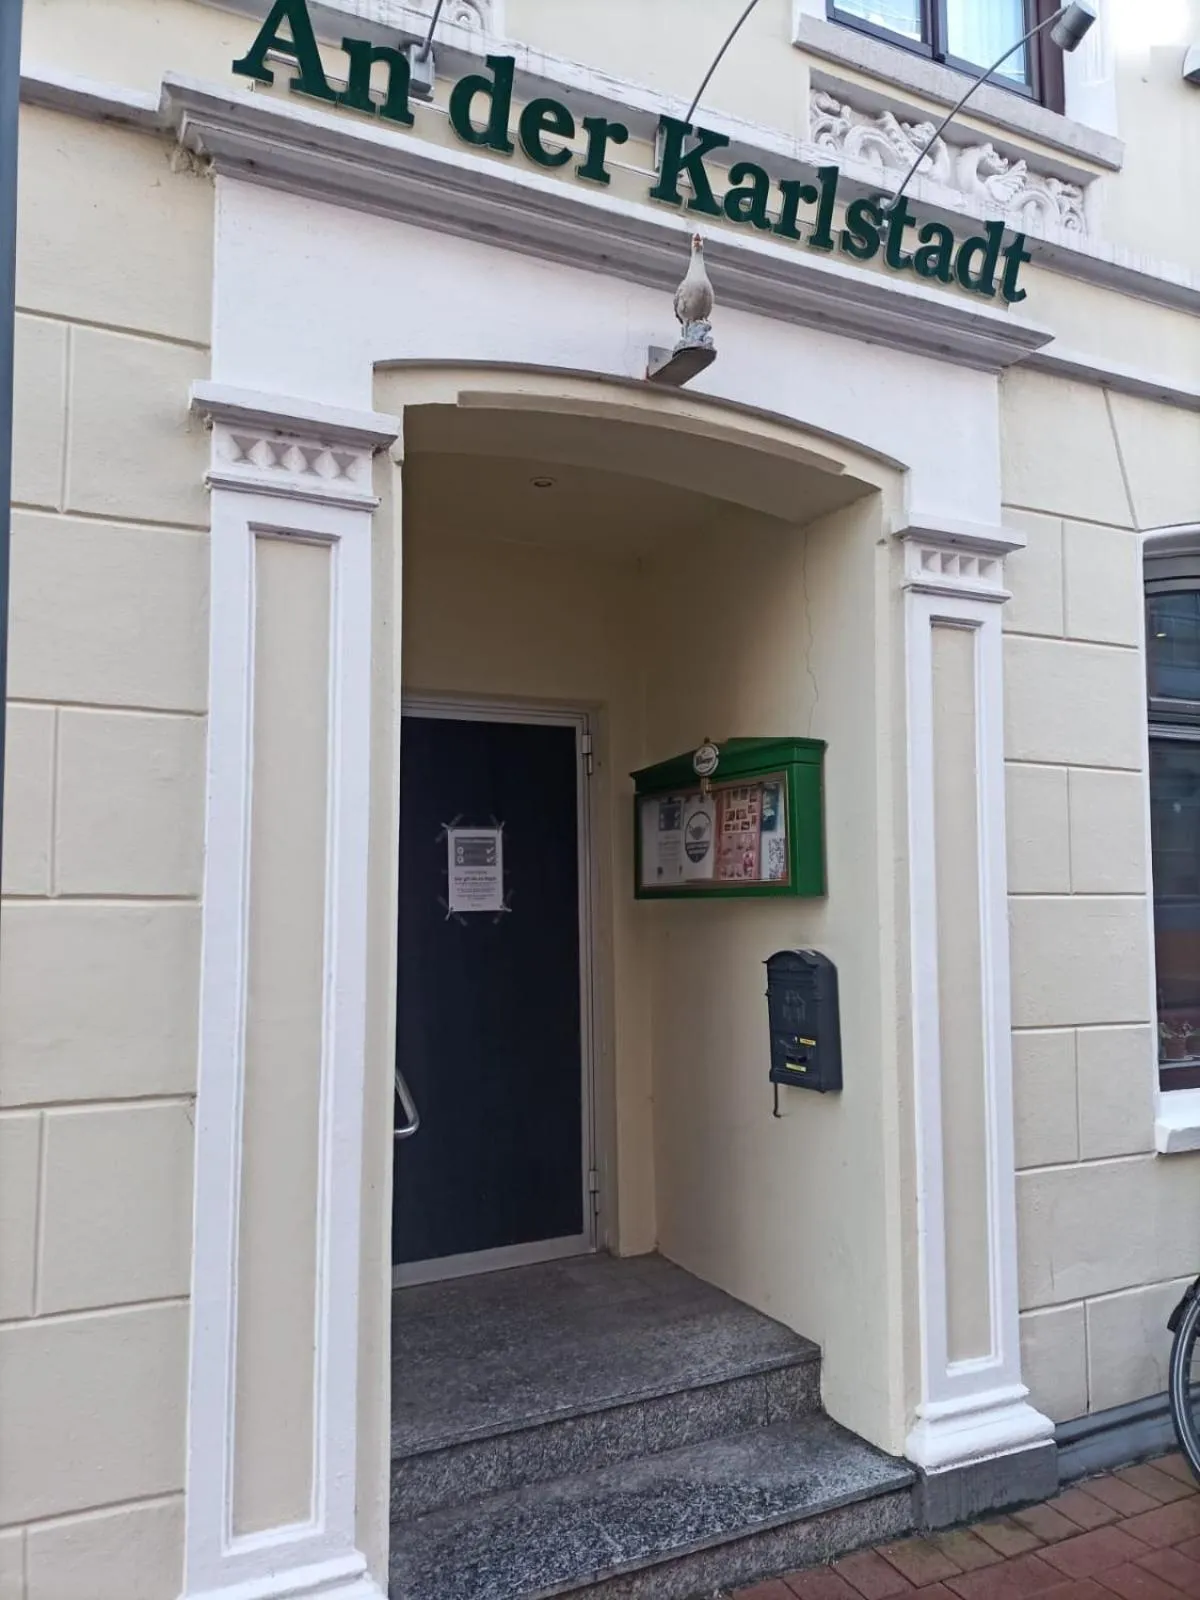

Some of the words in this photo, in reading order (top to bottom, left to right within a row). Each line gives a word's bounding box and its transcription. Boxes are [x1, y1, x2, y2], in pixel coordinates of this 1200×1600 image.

[232, 0, 415, 126] An
[449, 54, 627, 187] der
[649, 115, 1031, 303] Karlstadt
